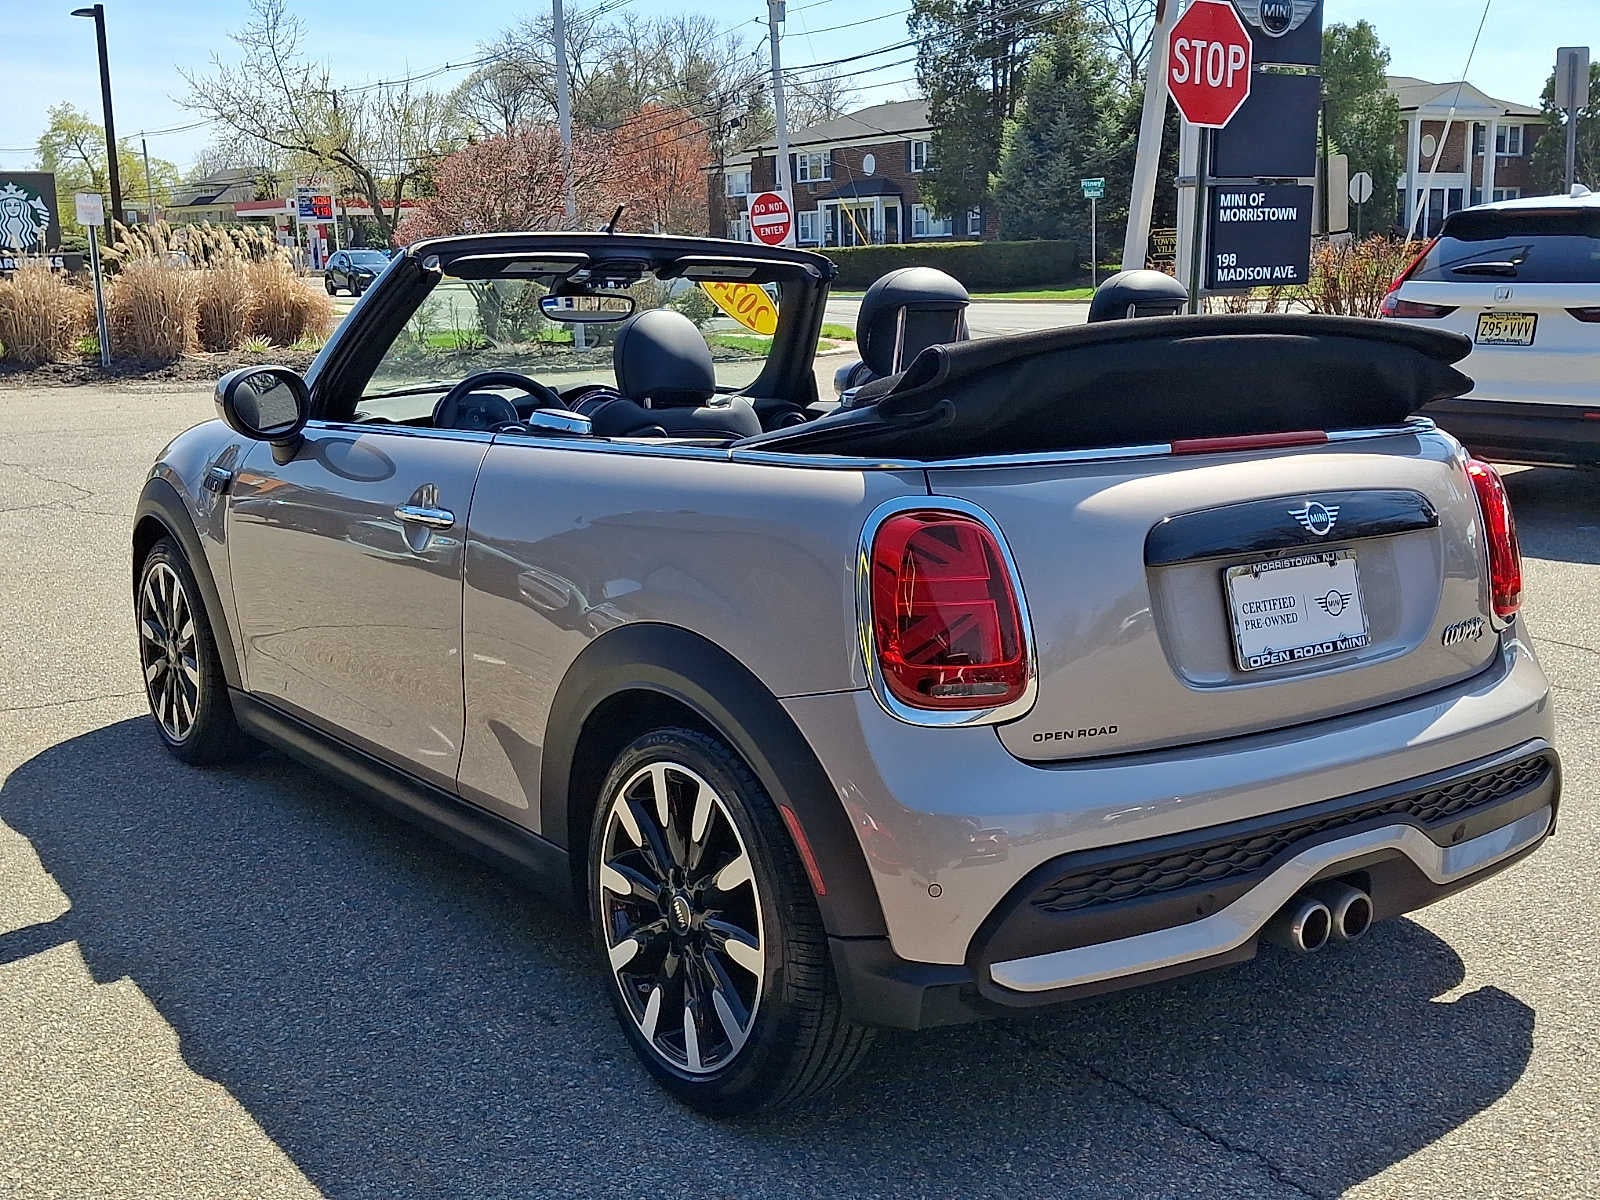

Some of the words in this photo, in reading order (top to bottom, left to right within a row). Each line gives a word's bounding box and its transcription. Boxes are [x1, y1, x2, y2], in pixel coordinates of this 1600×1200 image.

[1263, 3, 1290, 18] MINI
[1172, 37, 1246, 88] STOP
[1220, 193, 1247, 207] MINI
[1249, 193, 1265, 206] OF
[754, 204, 766, 213] DO
[768, 202, 783, 211] NOT
[1220, 208, 1297, 222] MORRISTOWN
[761, 226, 784, 236] ENTER
[1153, 237, 1177, 245] TOWN
[1217, 254, 1237, 267] 198
[1217, 267, 1271, 281] MADISON
[1273, 266, 1297, 279] AVE.
[1480, 321, 1502, 336] Z95
[1510, 321, 1531, 337] VVV
[1310, 513, 1328, 524] MINI
[1322, 552, 1336, 562] NJ
[1242, 596, 1296, 614] CERTIFIED
[1249, 650, 1290, 667] OPEN
[1294, 642, 1334, 658] ROAD
[1336, 635, 1367, 650] MINI
[1033, 730, 1074, 742] OPEN
[1078, 725, 1118, 738] ROAD
